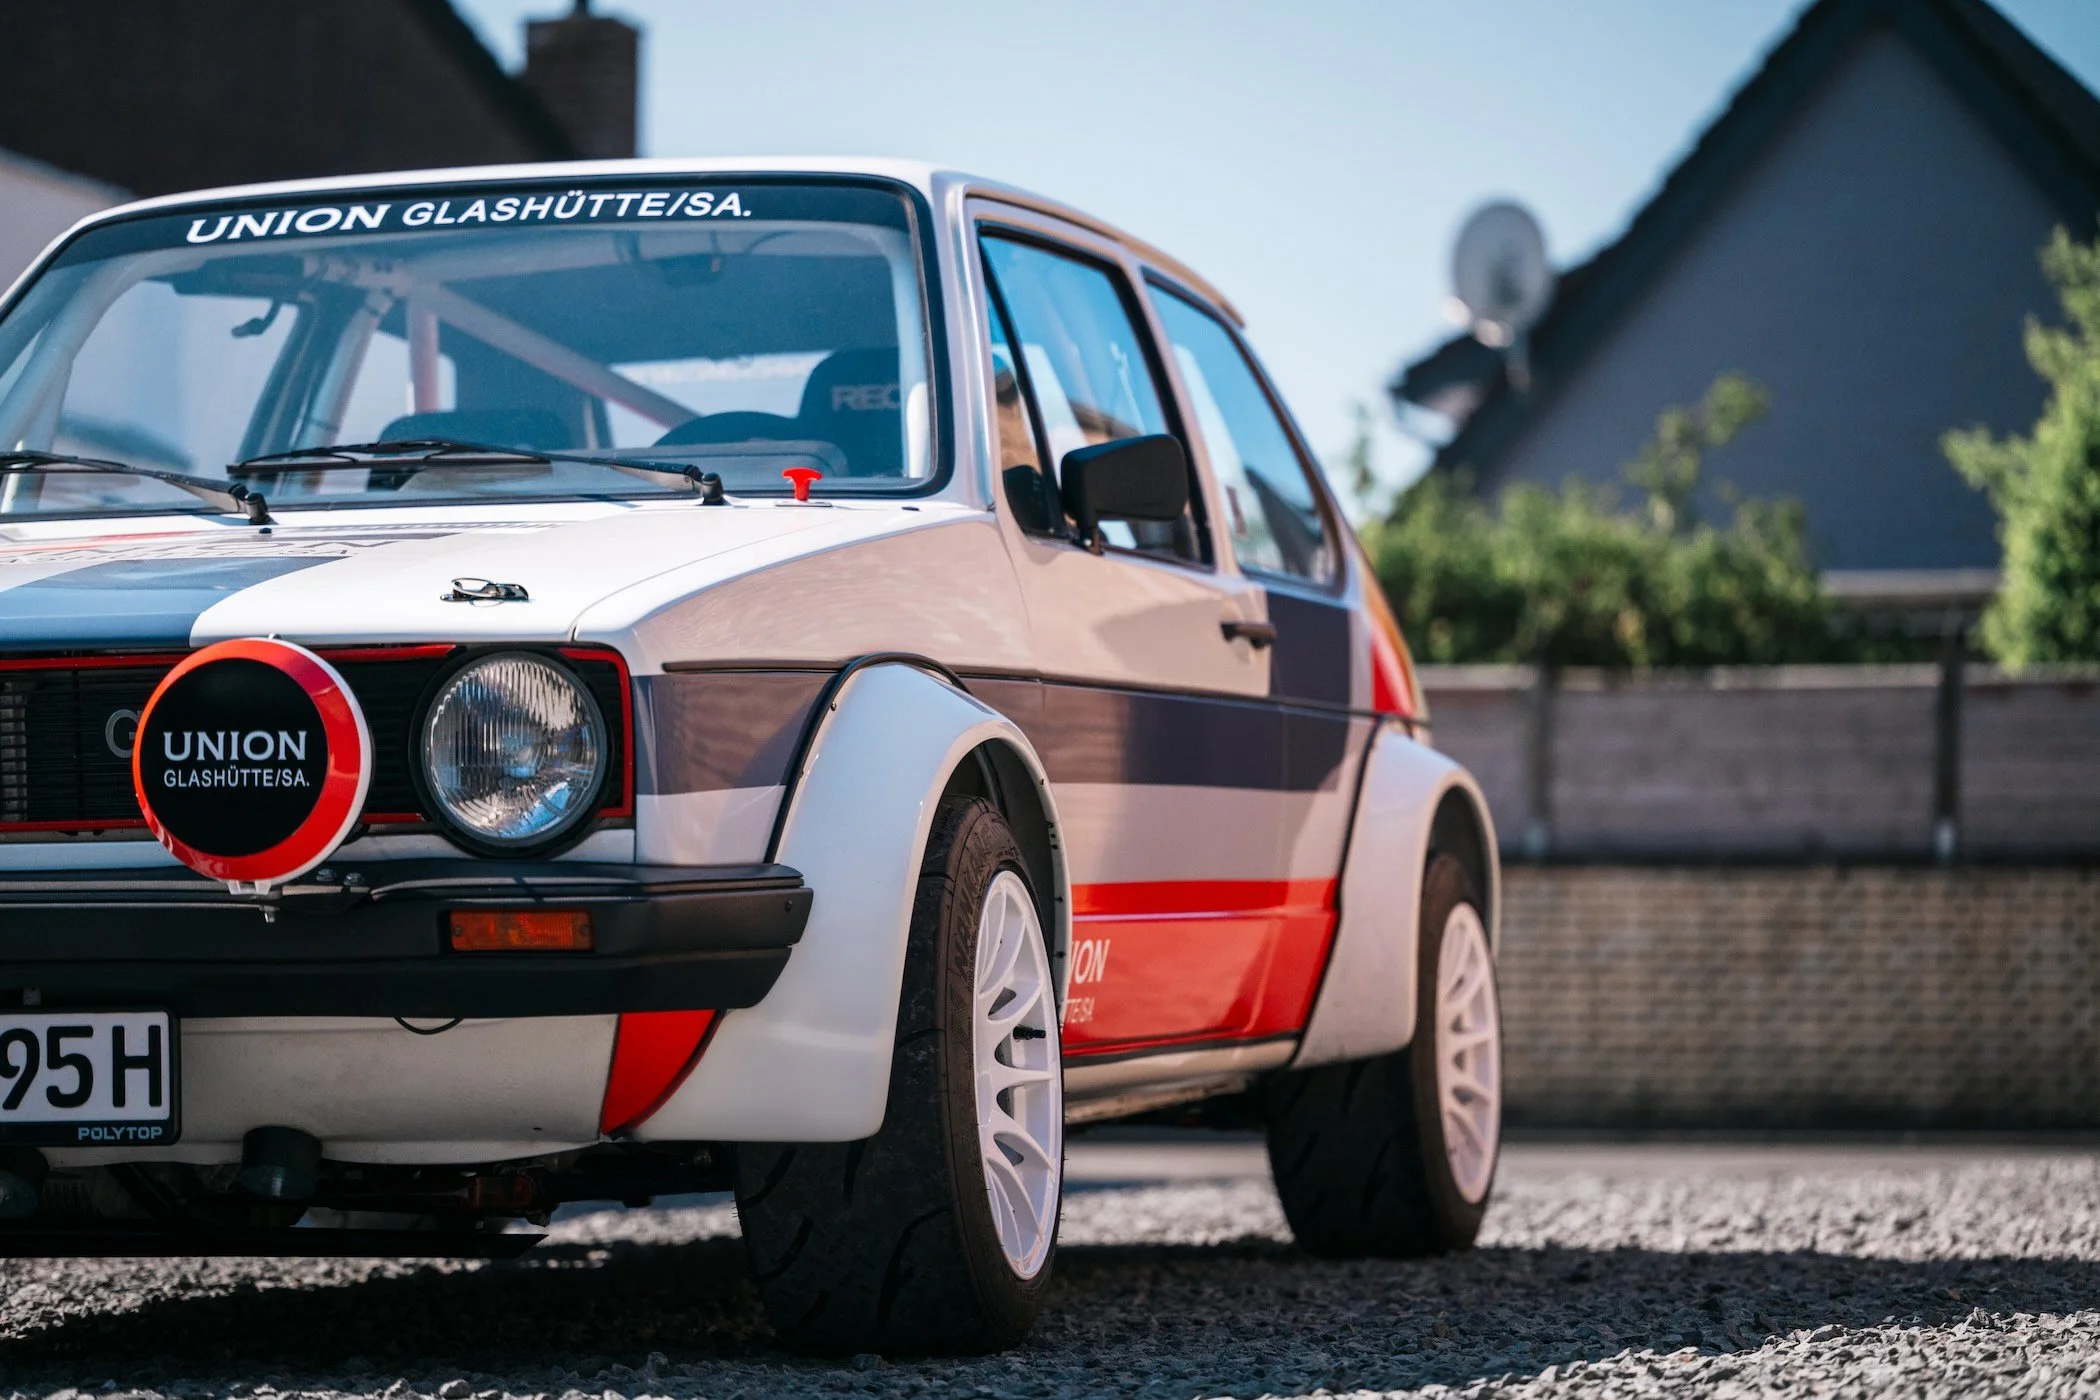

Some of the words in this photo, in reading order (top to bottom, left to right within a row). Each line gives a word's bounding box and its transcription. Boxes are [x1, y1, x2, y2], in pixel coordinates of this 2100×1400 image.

[186, 204, 391, 243] UNION
[402, 190, 752, 226] GLASHÜTTE/SA.
[163, 730, 308, 761] UNION
[163, 765, 310, 788] GLASHÜTTE/SA.
[78, 1126, 163, 1140] POLYTOP
